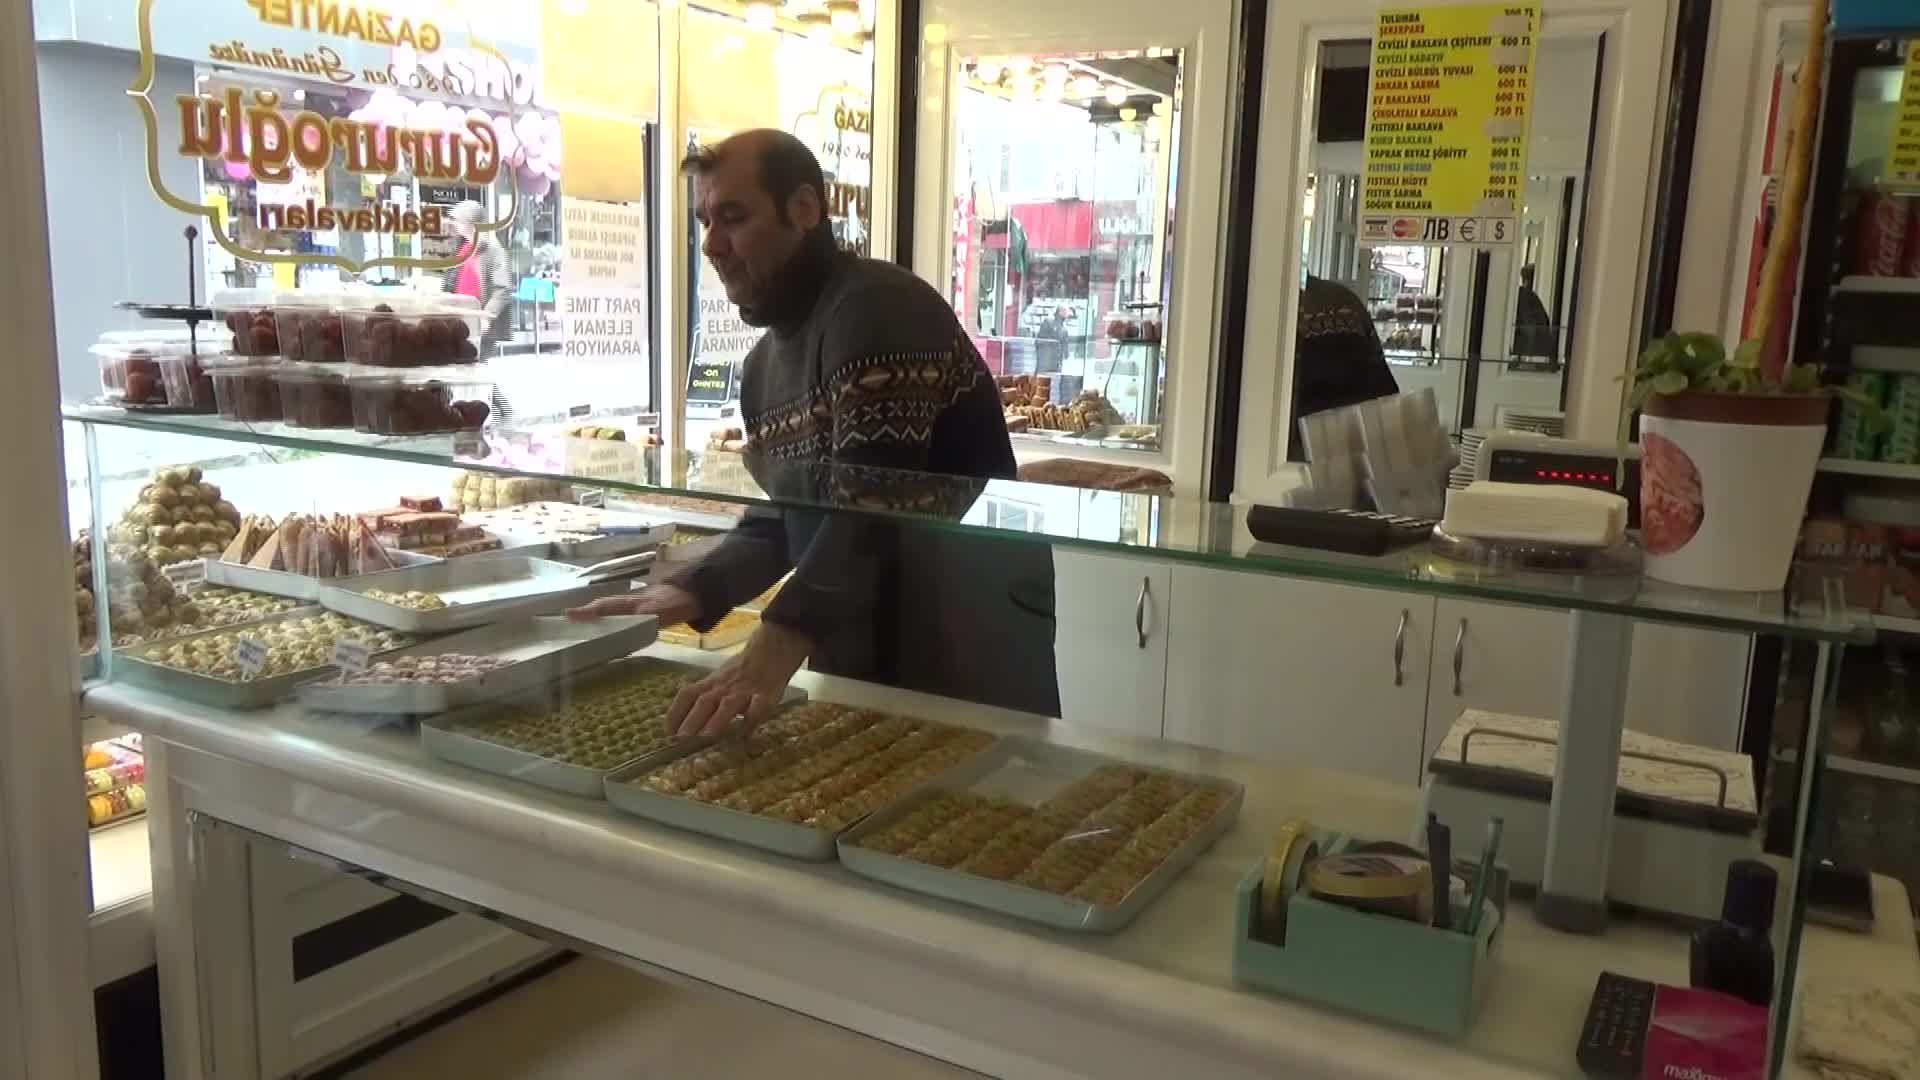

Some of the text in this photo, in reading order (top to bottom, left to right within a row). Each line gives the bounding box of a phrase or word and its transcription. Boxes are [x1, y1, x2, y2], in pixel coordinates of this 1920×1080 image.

[1378, 40, 1408, 50] CEVİZLİ
[1410, 38, 1448, 48] BAKLAVA
[1522, 36, 1530, 45] TL
[1375, 79, 1527, 90] ANKARA SARMA 600 TL
[1495, 92, 1512, 103] 600
[1516, 93, 1525, 102] TL
[1420, 107, 1458, 117] BAKLAVA
[1494, 107, 1512, 117] 750
[1515, 107, 1524, 116] TL
[1406, 122, 1443, 131] BAKLAVA
[1512, 148, 1520, 157] TL
[1509, 163, 1519, 171] TL
[1509, 176, 1517, 185] TL
[1394, 189, 1422, 198] SARMA
[1366, 199, 1392, 209] SOĞUK
[1395, 200, 1432, 209] BAKLAVA
